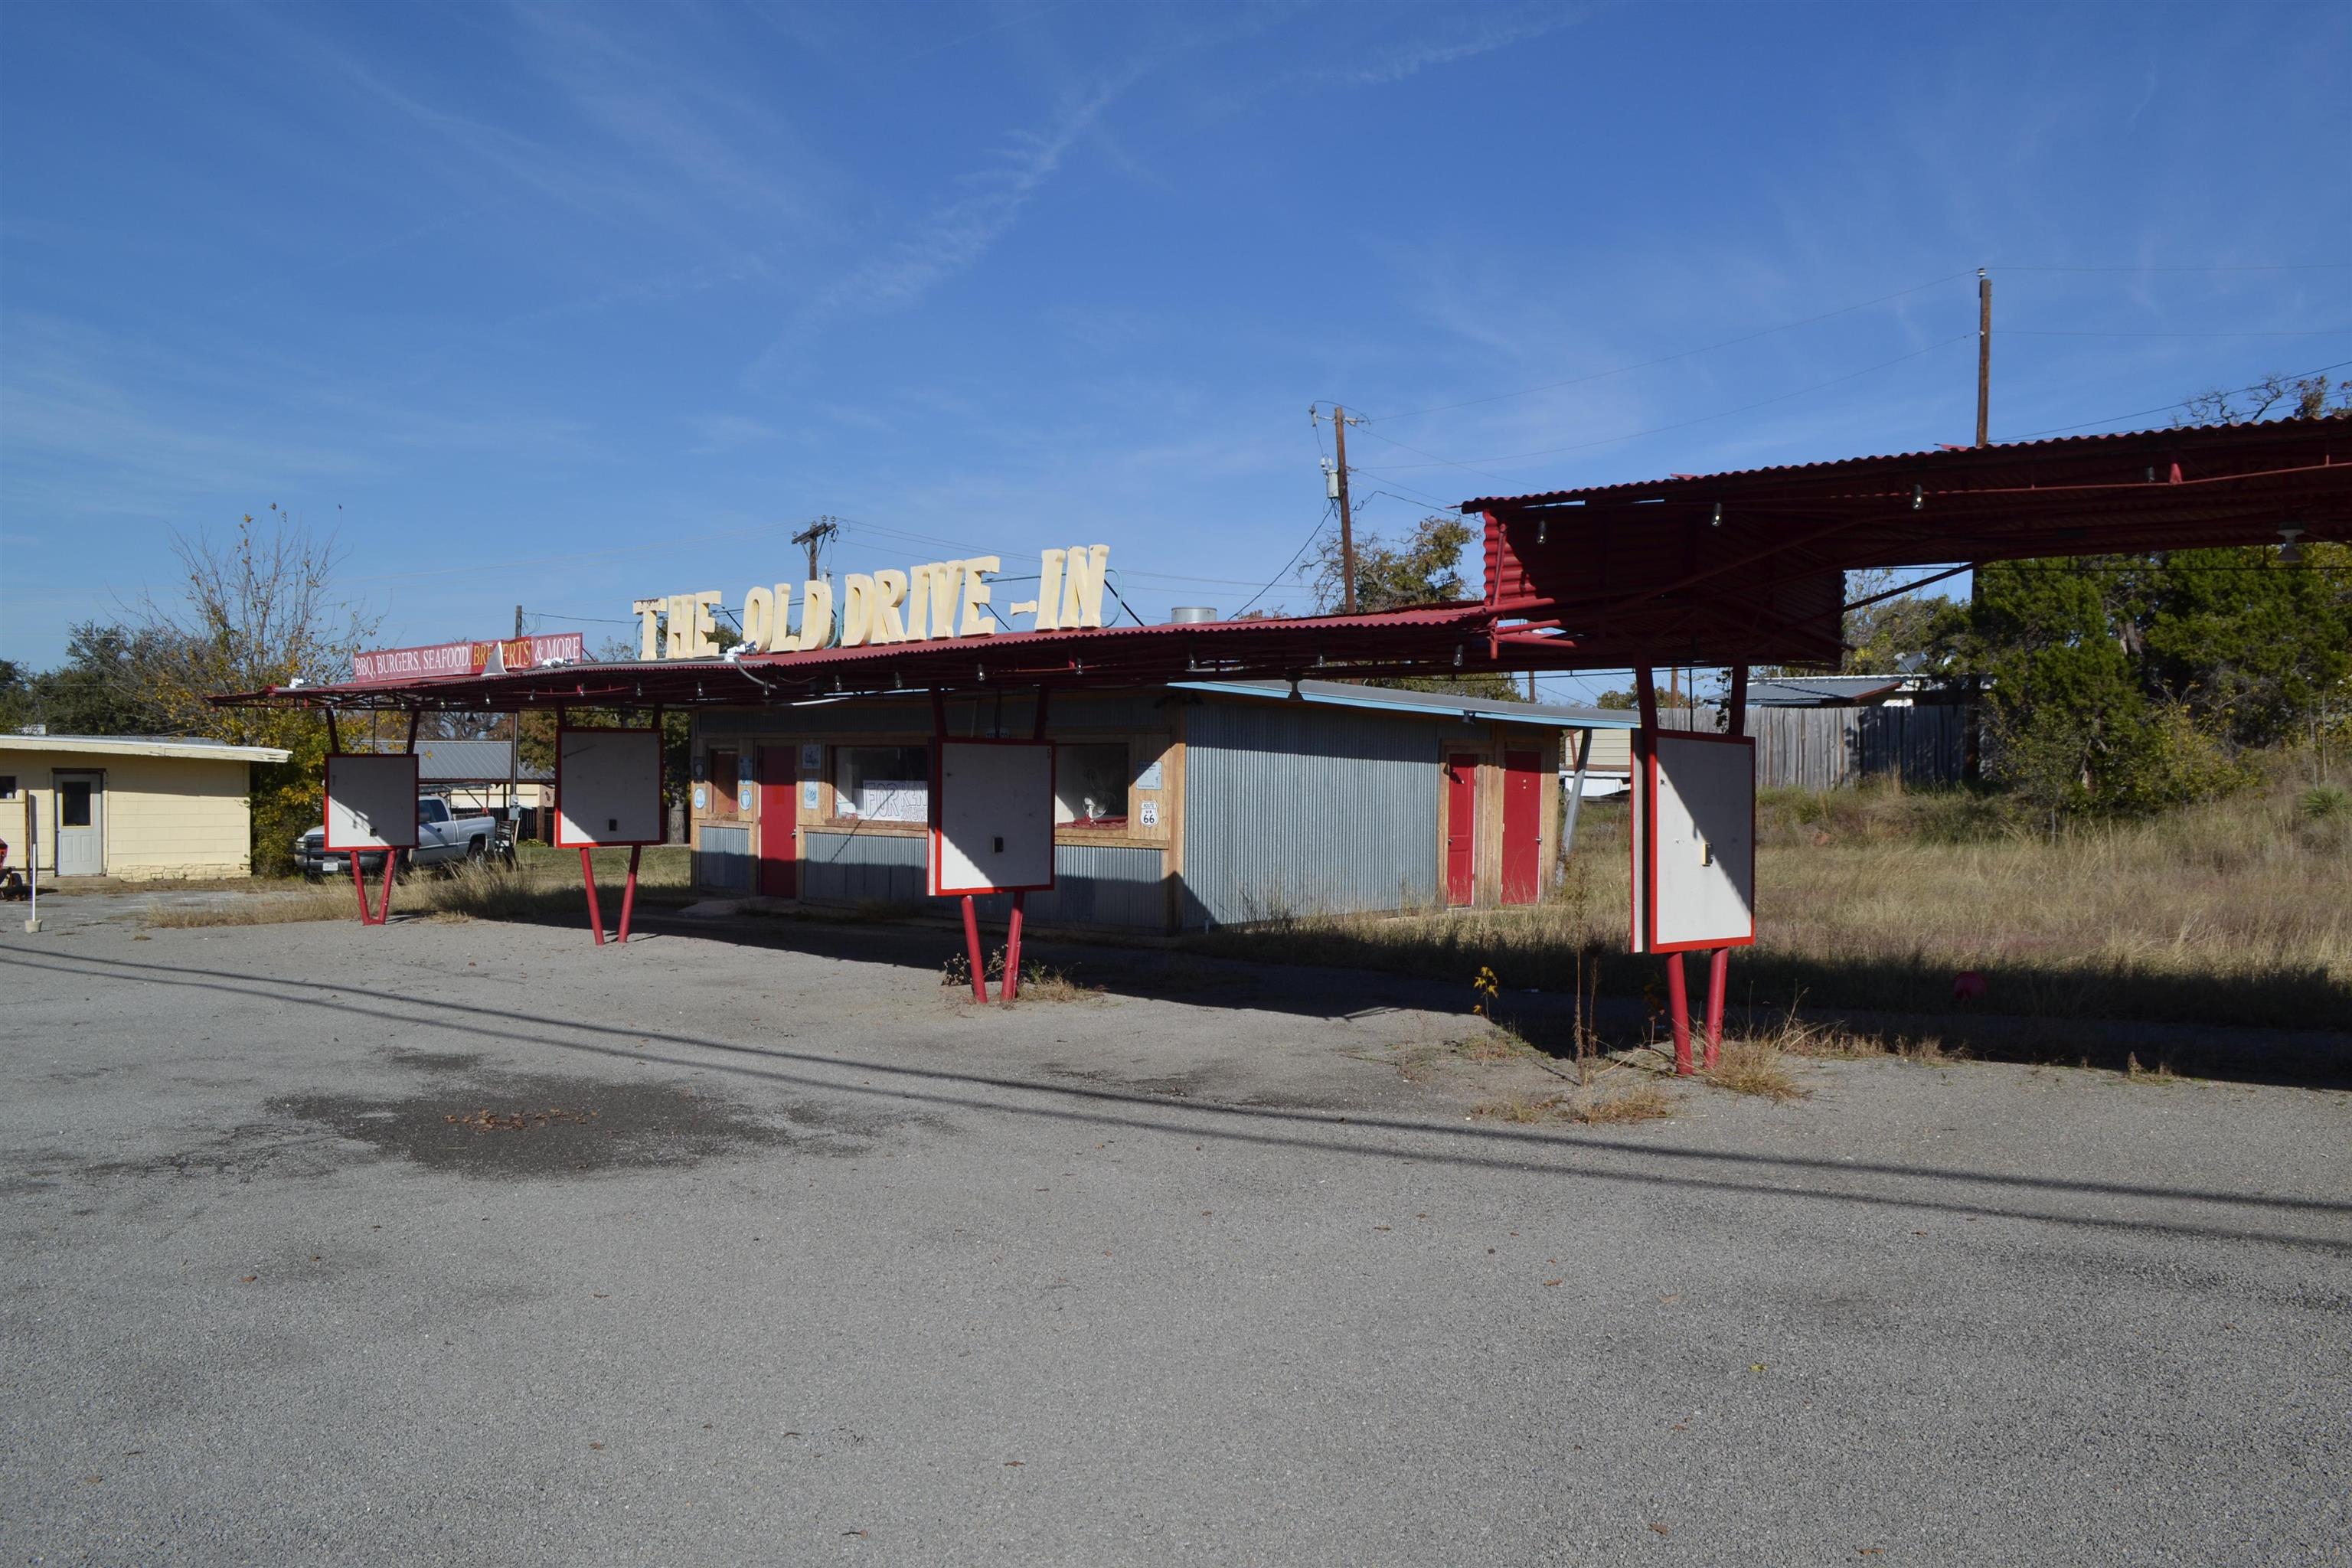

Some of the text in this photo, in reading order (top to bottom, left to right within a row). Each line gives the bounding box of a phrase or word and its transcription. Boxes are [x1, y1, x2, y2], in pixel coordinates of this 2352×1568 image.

[632, 590, 722, 661] THE
[743, 580, 832, 655] OLD
[354, 657, 376, 679] BBQ,
[377, 652, 421, 674] BURGERS,
[536, 642, 544, 662] &
[547, 636, 580, 660] MORE
[864, 782, 900, 817] FOR
[901, 781, 927, 808] REN
[1144, 814, 1155, 824] 66
